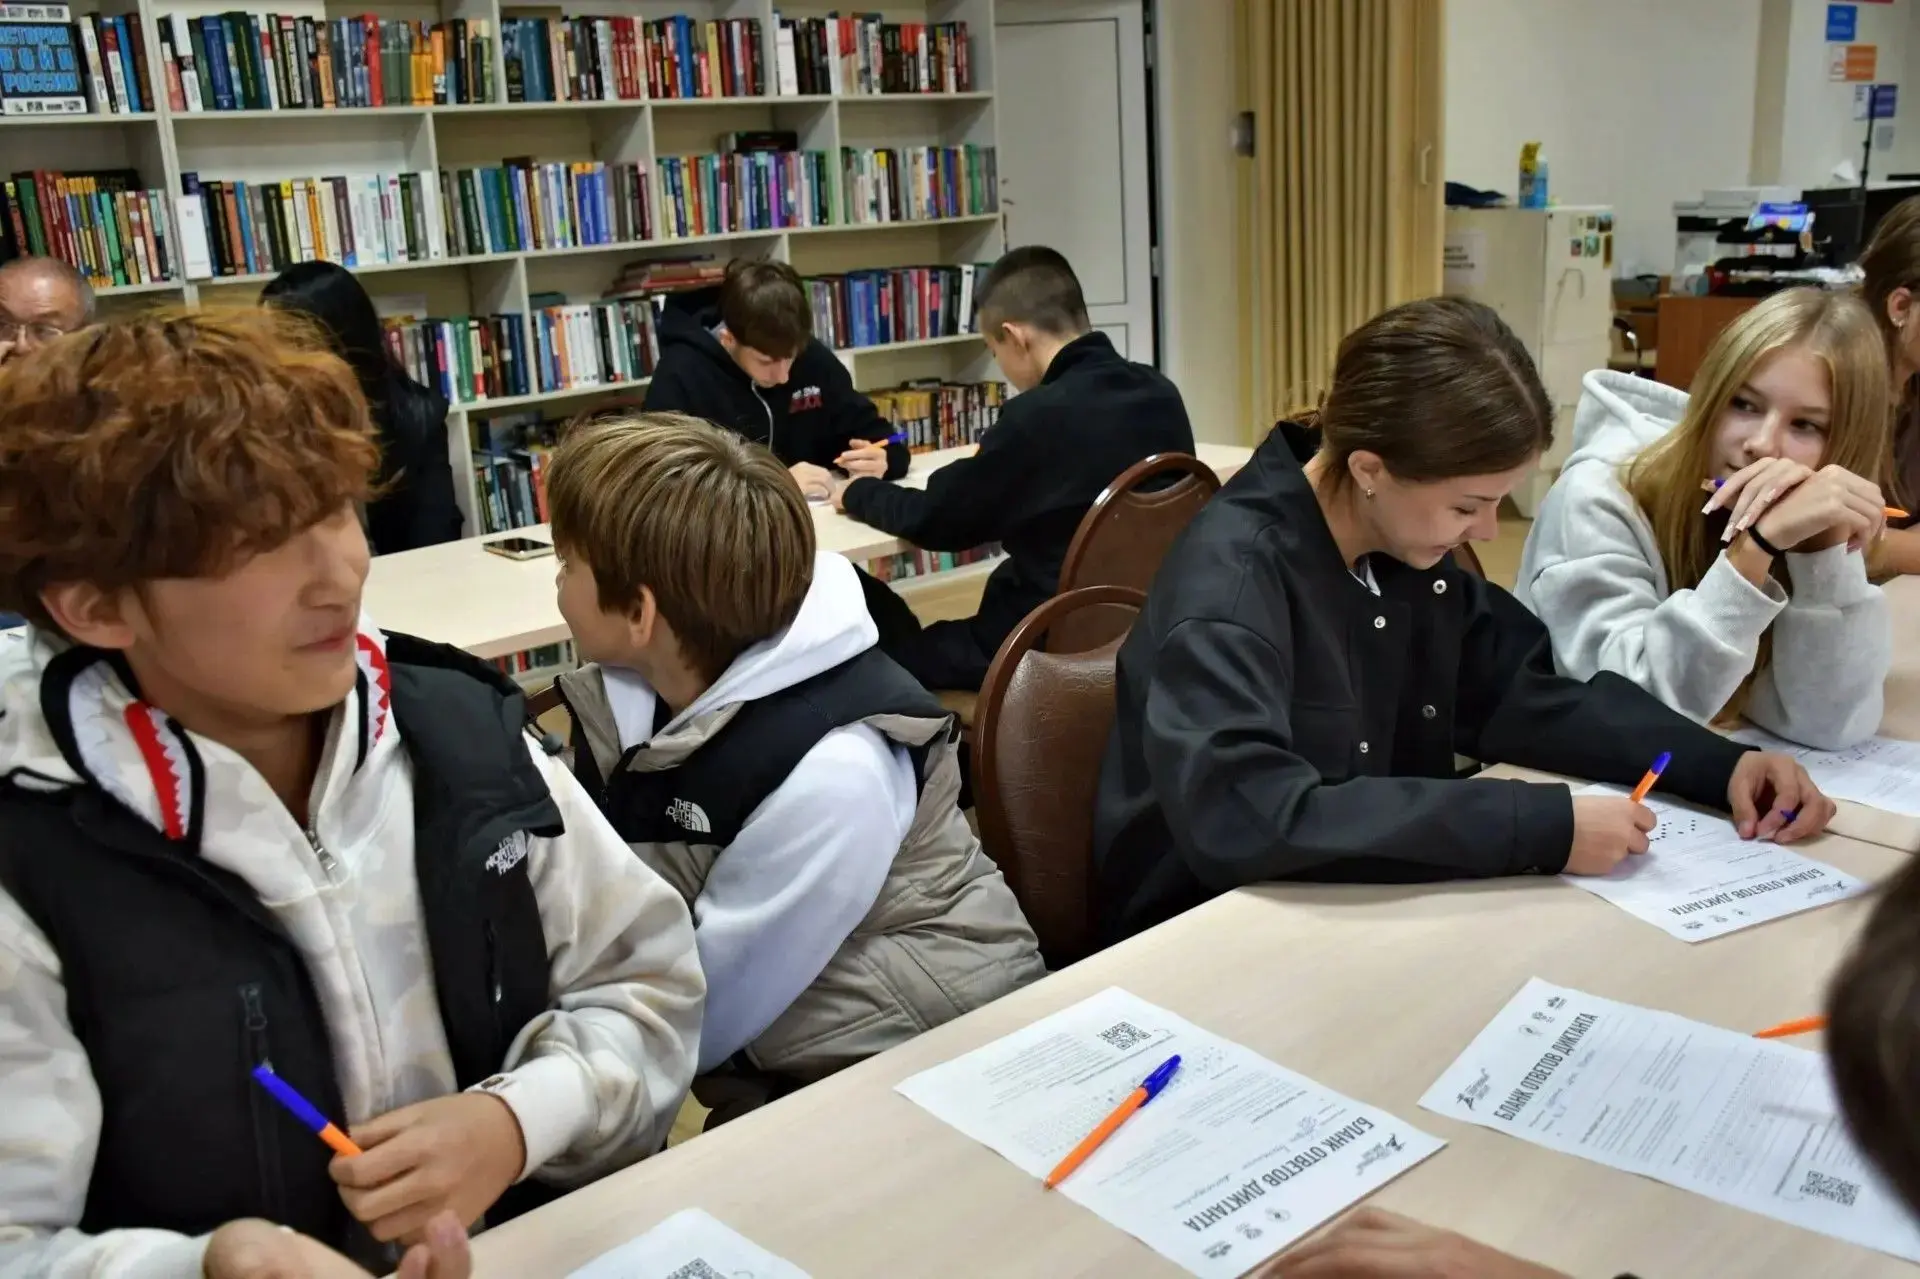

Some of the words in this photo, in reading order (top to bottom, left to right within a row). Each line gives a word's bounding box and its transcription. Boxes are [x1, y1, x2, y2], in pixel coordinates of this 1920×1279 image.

[665, 805, 692, 821] OTH
[673, 797, 692, 811] THE
[1786, 868, 1825, 886] БЛАНК
[1731, 880, 1785, 899] ОТВЕТОВ
[1668, 893, 1733, 916] ДИКТАНТА
[1493, 1088, 1534, 1121] БЛАНК
[1520, 1052, 1563, 1090] ОТВЕТОВ
[1552, 1012, 1599, 1056] ДИКТАНТА
[1322, 1116, 1375, 1152] БЛАНК
[1261, 1148, 1328, 1187] ОТВЕТОВ
[1182, 1178, 1267, 1232] ДИКТАНТА
